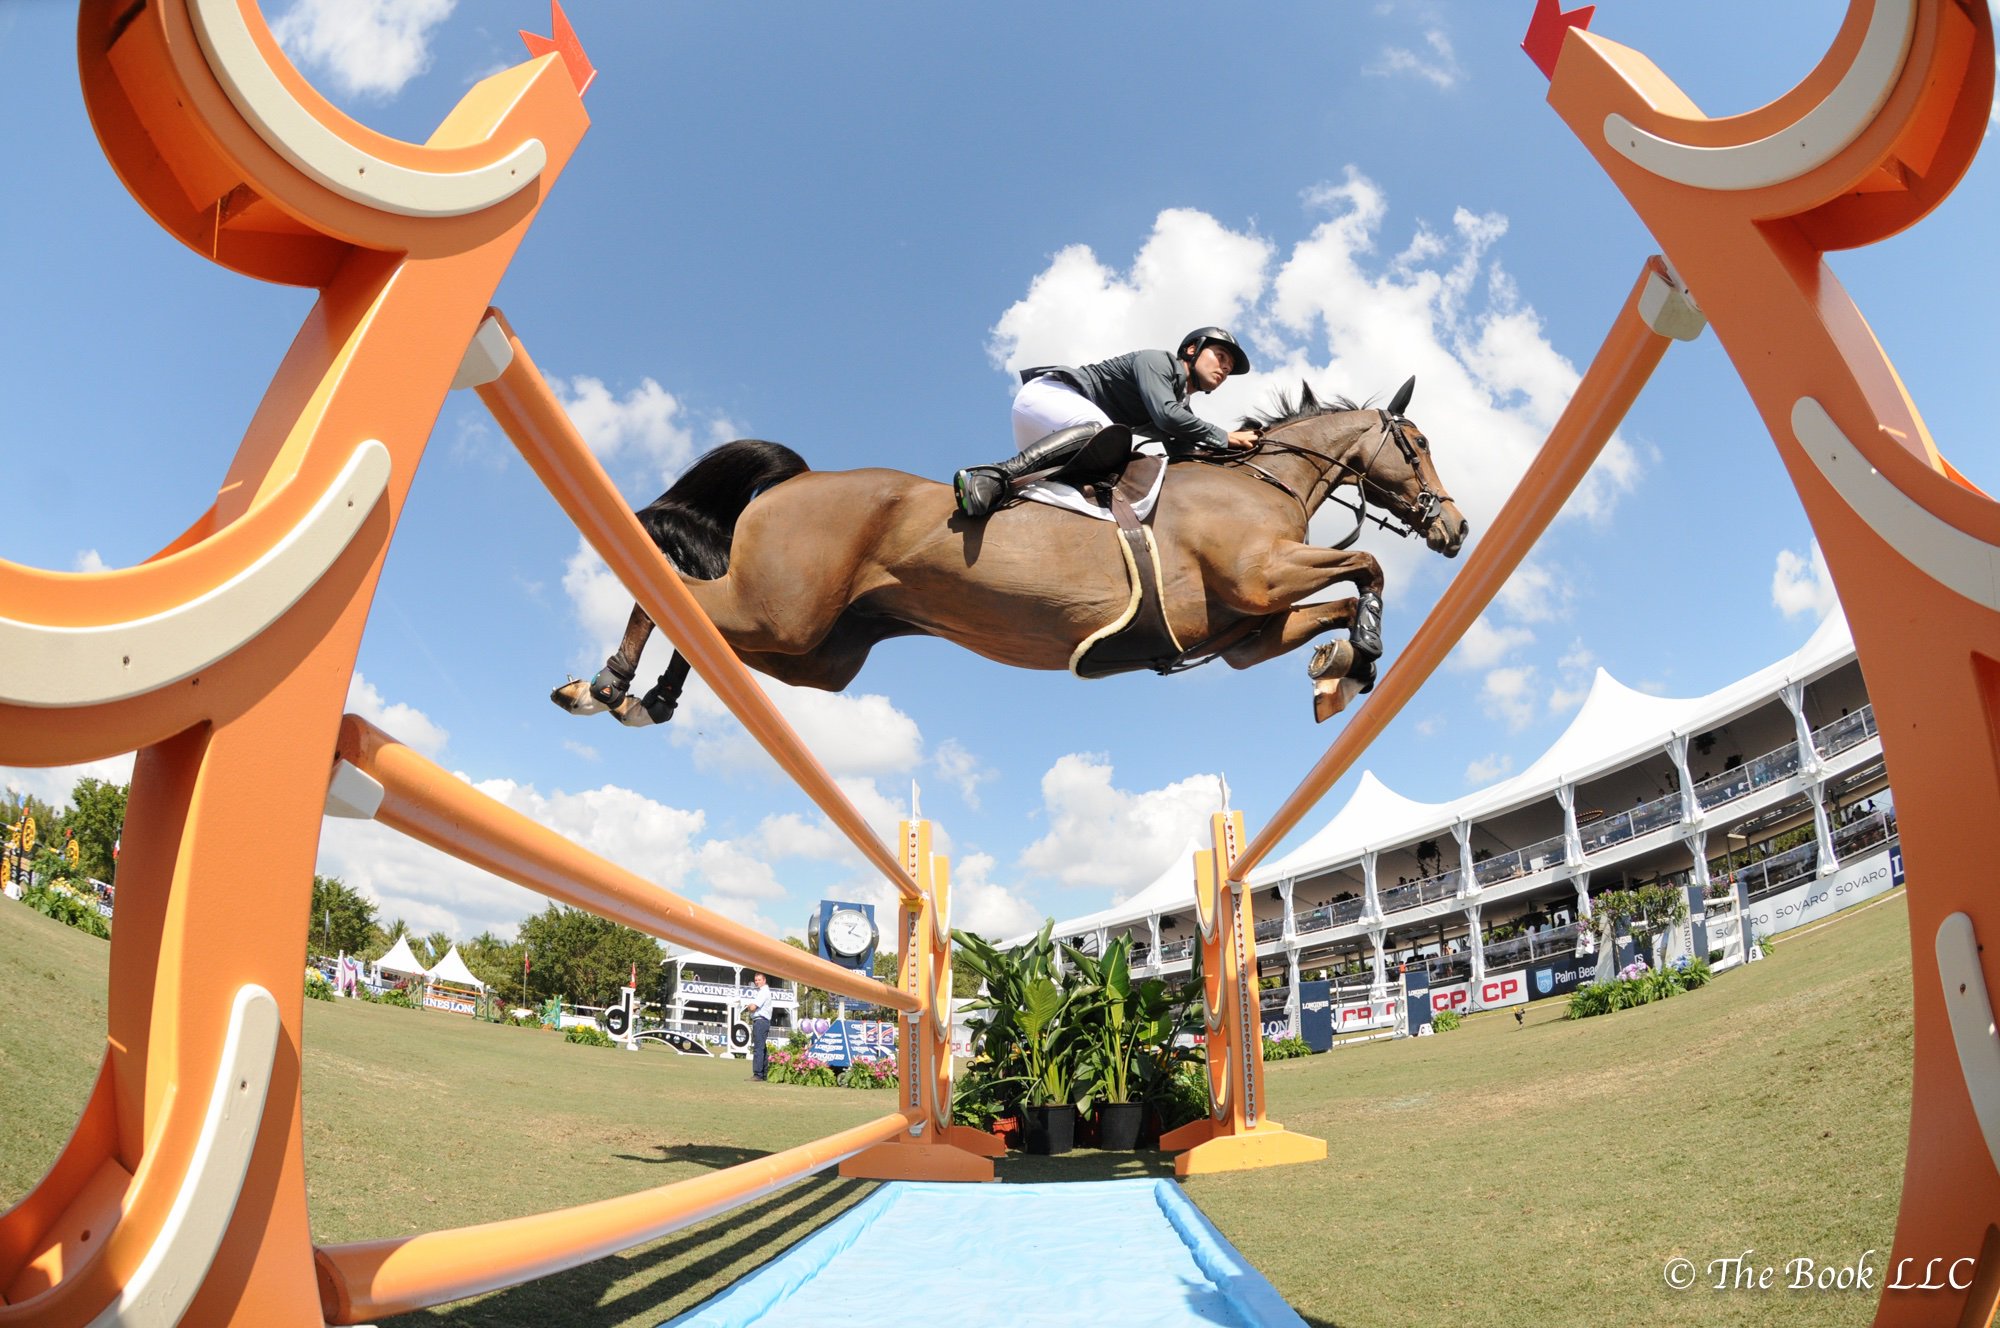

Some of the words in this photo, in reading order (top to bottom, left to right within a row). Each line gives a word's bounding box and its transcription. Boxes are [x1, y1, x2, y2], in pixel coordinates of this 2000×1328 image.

[1776, 892, 1829, 919] SOVARO
[1836, 868, 1888, 896] SOVARO
[1555, 970, 1577, 984] Palm
[681, 983, 736, 996] LONGINES
[1483, 980, 1517, 1003] CP
[1433, 990, 1467, 1013] CP
